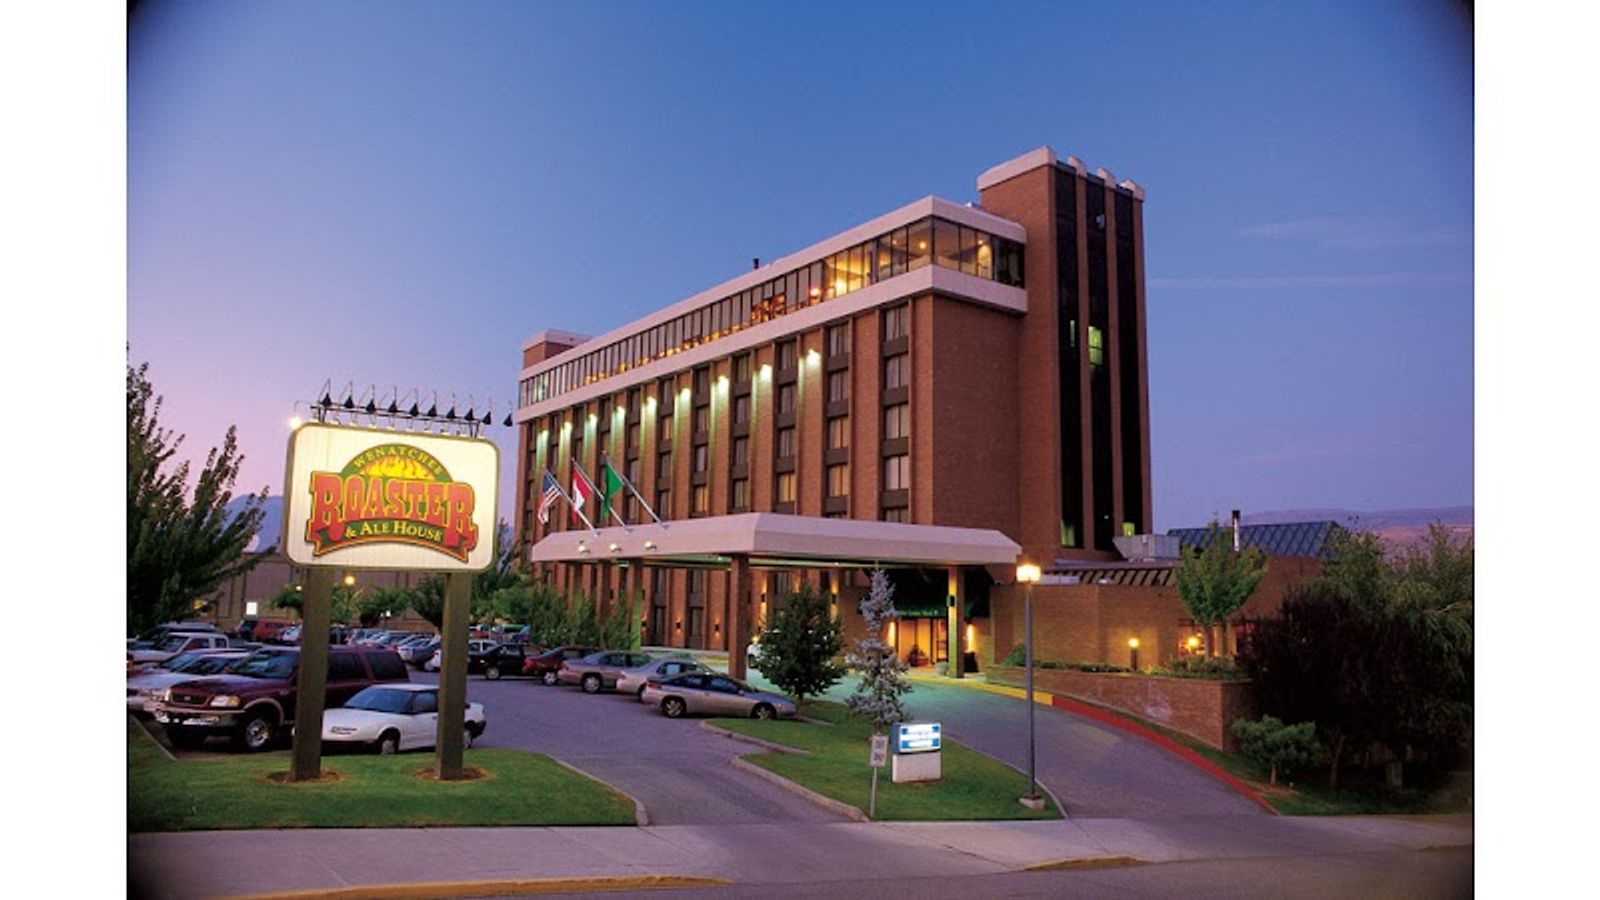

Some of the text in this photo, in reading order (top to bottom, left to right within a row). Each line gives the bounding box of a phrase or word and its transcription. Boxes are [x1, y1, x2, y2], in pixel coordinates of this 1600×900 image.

[353, 446, 444, 475] WENATCHEE
[308, 473, 478, 549] ROASTER
[345, 519, 443, 542] & ALE HOUSE
